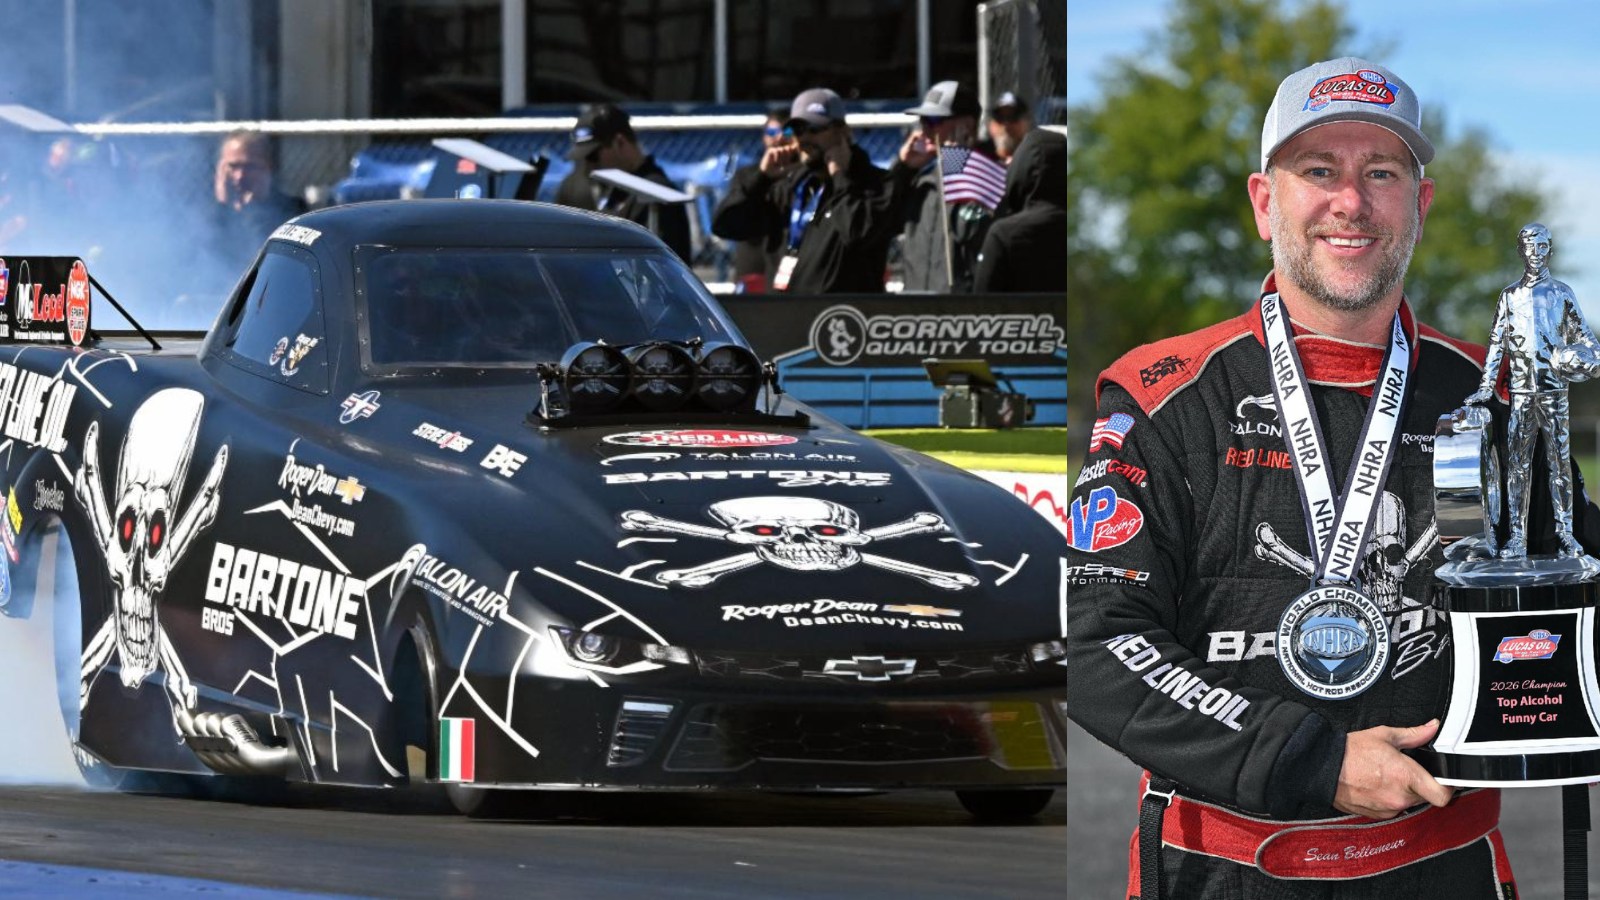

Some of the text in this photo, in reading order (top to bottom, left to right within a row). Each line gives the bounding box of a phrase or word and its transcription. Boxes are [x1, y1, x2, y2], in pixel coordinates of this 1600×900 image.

[1314, 80, 1388, 98] LUCAS OIL
[70, 280, 86, 300] NGK
[867, 319, 1055, 339] CORNWELL
[865, 340, 1057, 355] QUALITY TOOLS
[1272, 341, 1299, 400] NHRA
[1378, 366, 1405, 417] NHRA
[40, 379, 77, 452] OIL
[1228, 420, 1283, 438] TALON
[1401, 433, 1435, 445] Roger
[804, 453, 857, 461] AIR
[1225, 447, 1293, 469] RED LINE
[1291, 417, 1322, 478] NHRA
[278, 454, 337, 497] Roger Dean
[603, 470, 892, 485] BARTONE
[1075, 458, 1148, 487] astercam
[1354, 440, 1388, 496] NHRA
[291, 498, 355, 536] DeanChevy.com
[1071, 486, 1117, 552] VP
[1313, 498, 1335, 552] NHR
[1095, 518, 1142, 544] Racing
[1329, 521, 1364, 579] NHRA
[1067, 563, 1150, 581] ETSPEED
[205, 542, 367, 640] BARTONE
[416, 554, 508, 618] TALON AIR
[201, 606, 235, 636] BROS
[721, 599, 878, 621] Roger Dean
[783, 613, 964, 631] DeanChevy.com
[1280, 589, 1387, 643] WORLD CHAMPION
[1100, 633, 1162, 672] RED
[1304, 627, 1365, 654] NHRA
[1502, 641, 1552, 651] LUCAS OIL
[1281, 646, 1306, 686] NATIONAL
[1306, 681, 1324, 693] HOT
[1345, 650, 1385, 694] ASSOCIATION
[1490, 679, 1568, 692] 2026 Champion
[1497, 694, 1563, 708] Top Alcohol
[1502, 711, 1558, 725] Funny Car
[1304, 838, 1406, 862] Sean Bellemeur
